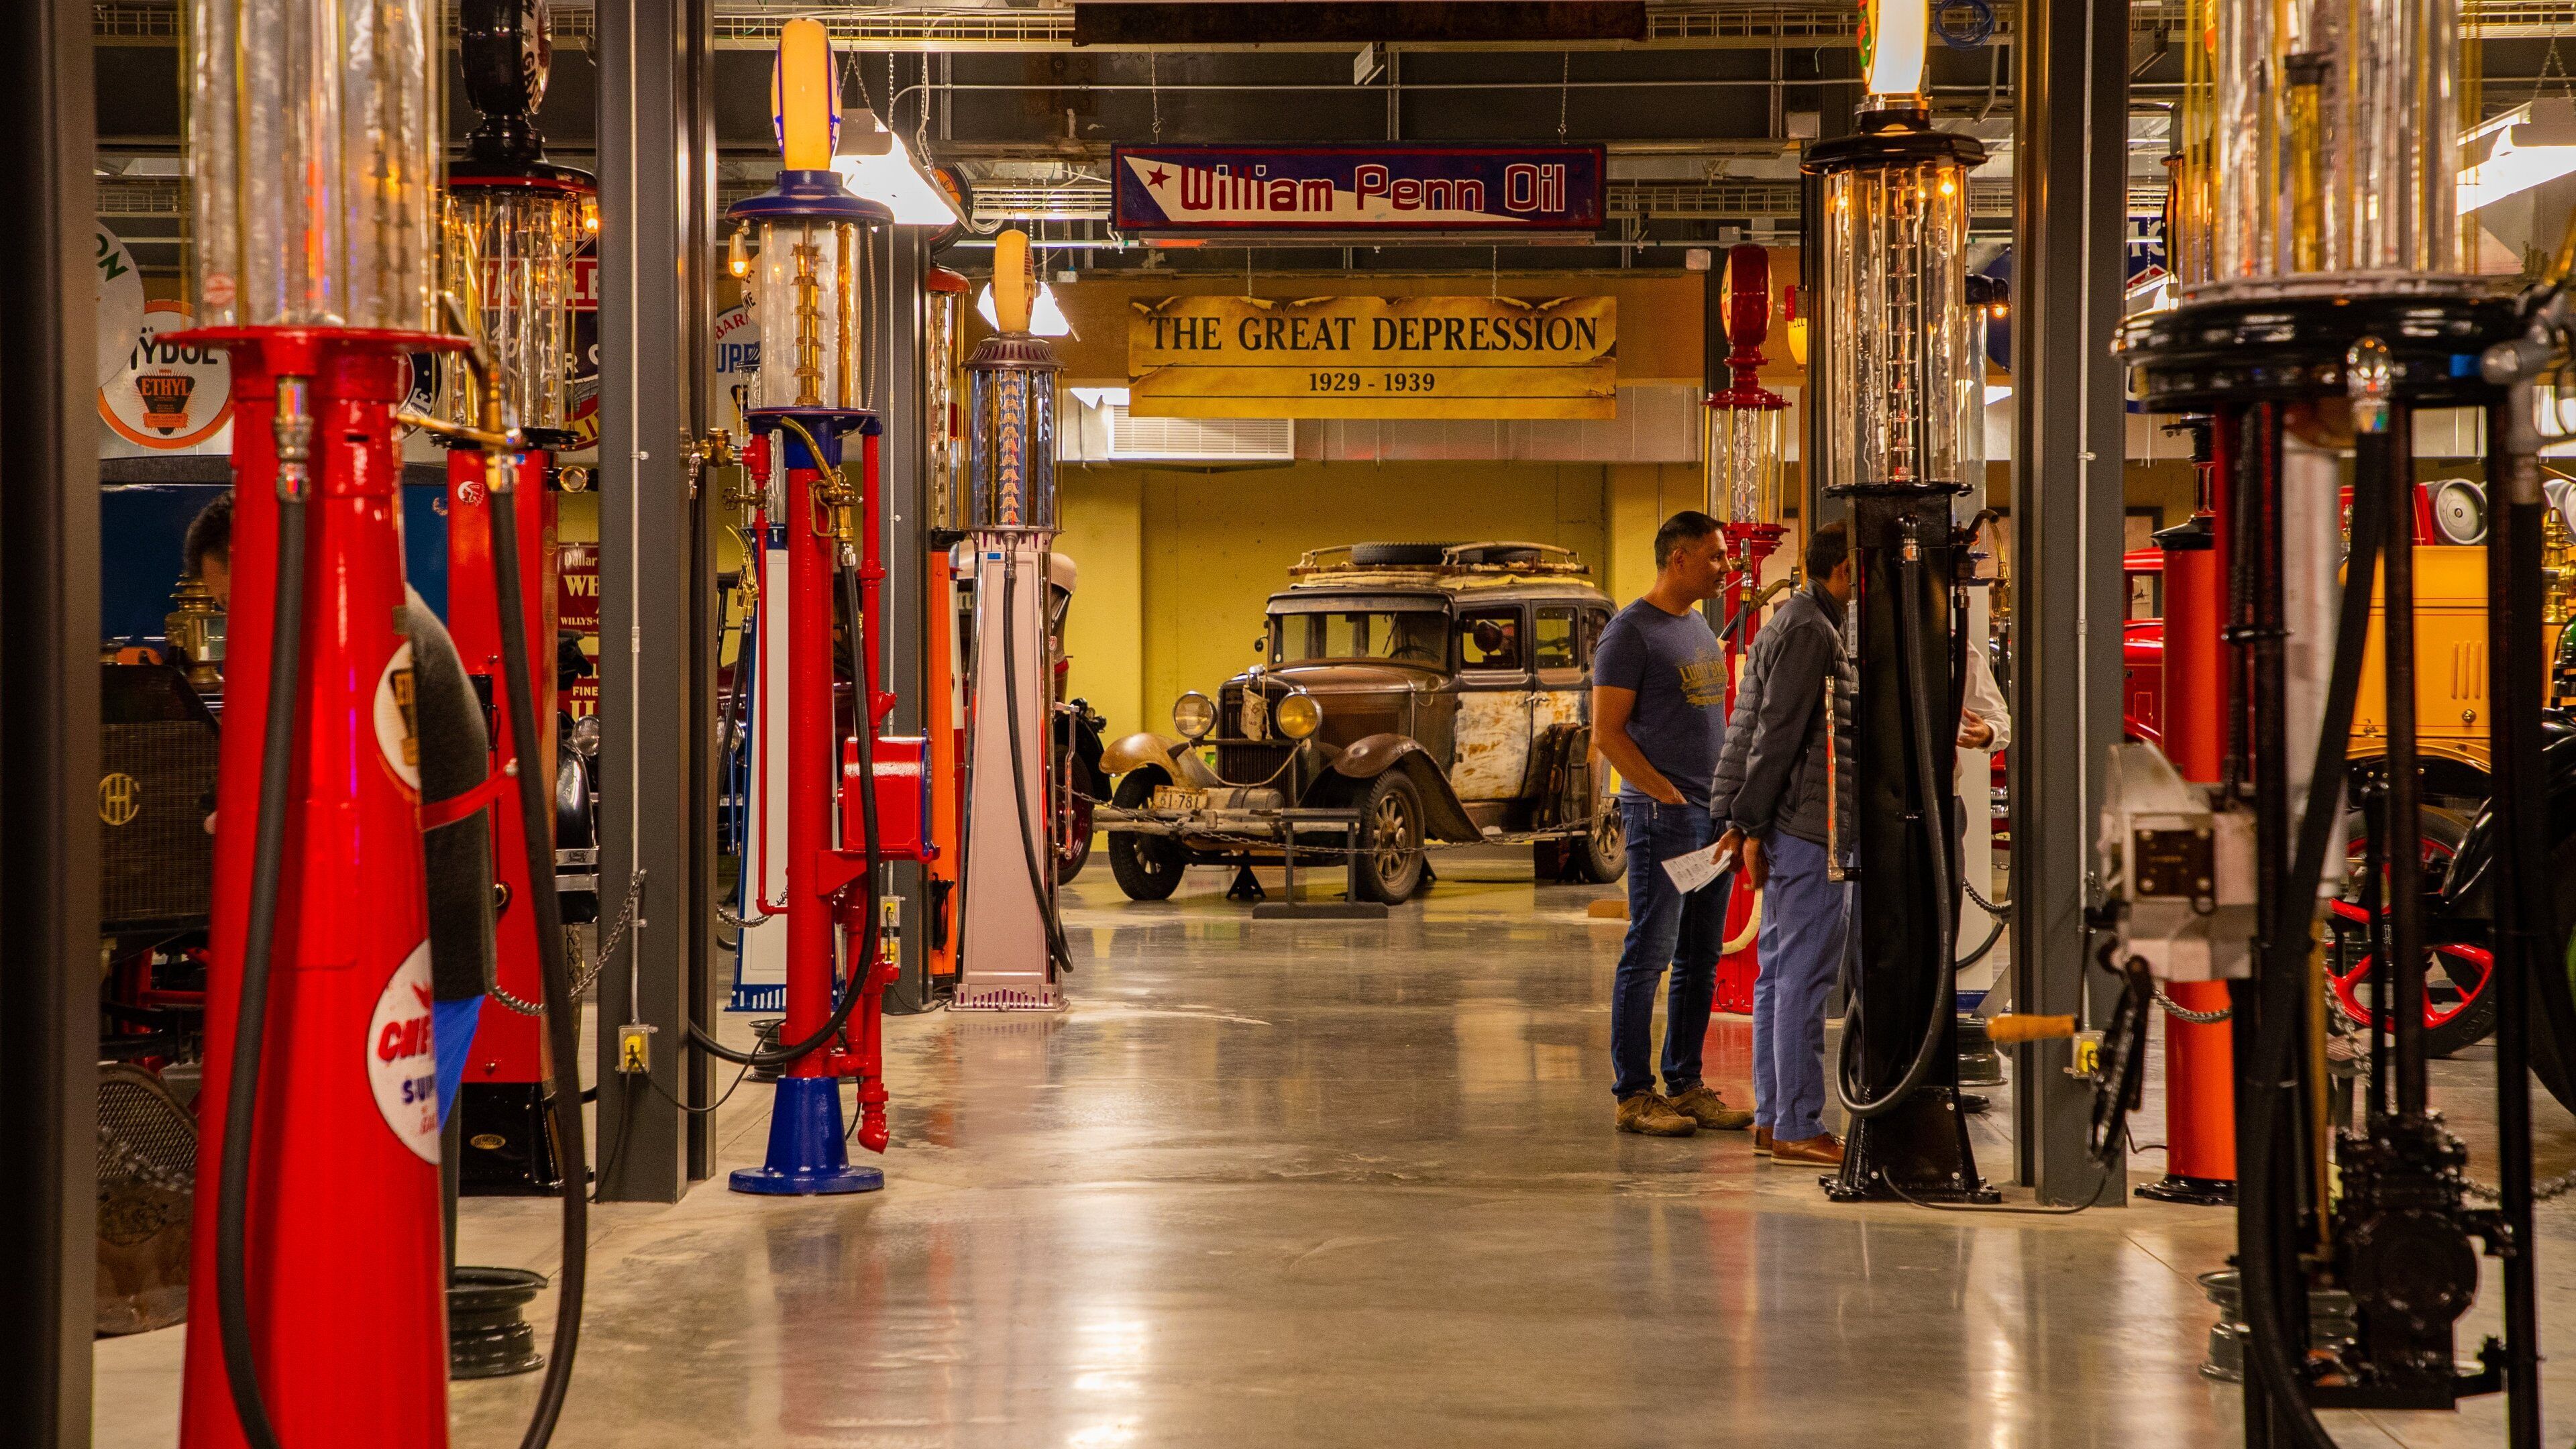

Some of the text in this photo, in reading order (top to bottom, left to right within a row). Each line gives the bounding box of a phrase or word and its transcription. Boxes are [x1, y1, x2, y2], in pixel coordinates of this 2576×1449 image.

[1181, 163, 1565, 212] William Penn Oil
[1148, 316, 1598, 351] THE GREAT DEPRESSION
[142, 378, 190, 396] ETHYL
[1309, 372, 1360, 391] 1929
[1385, 372, 1435, 391] 1939
[564, 550, 598, 567] Dollar
[572, 686, 598, 696] FINE
